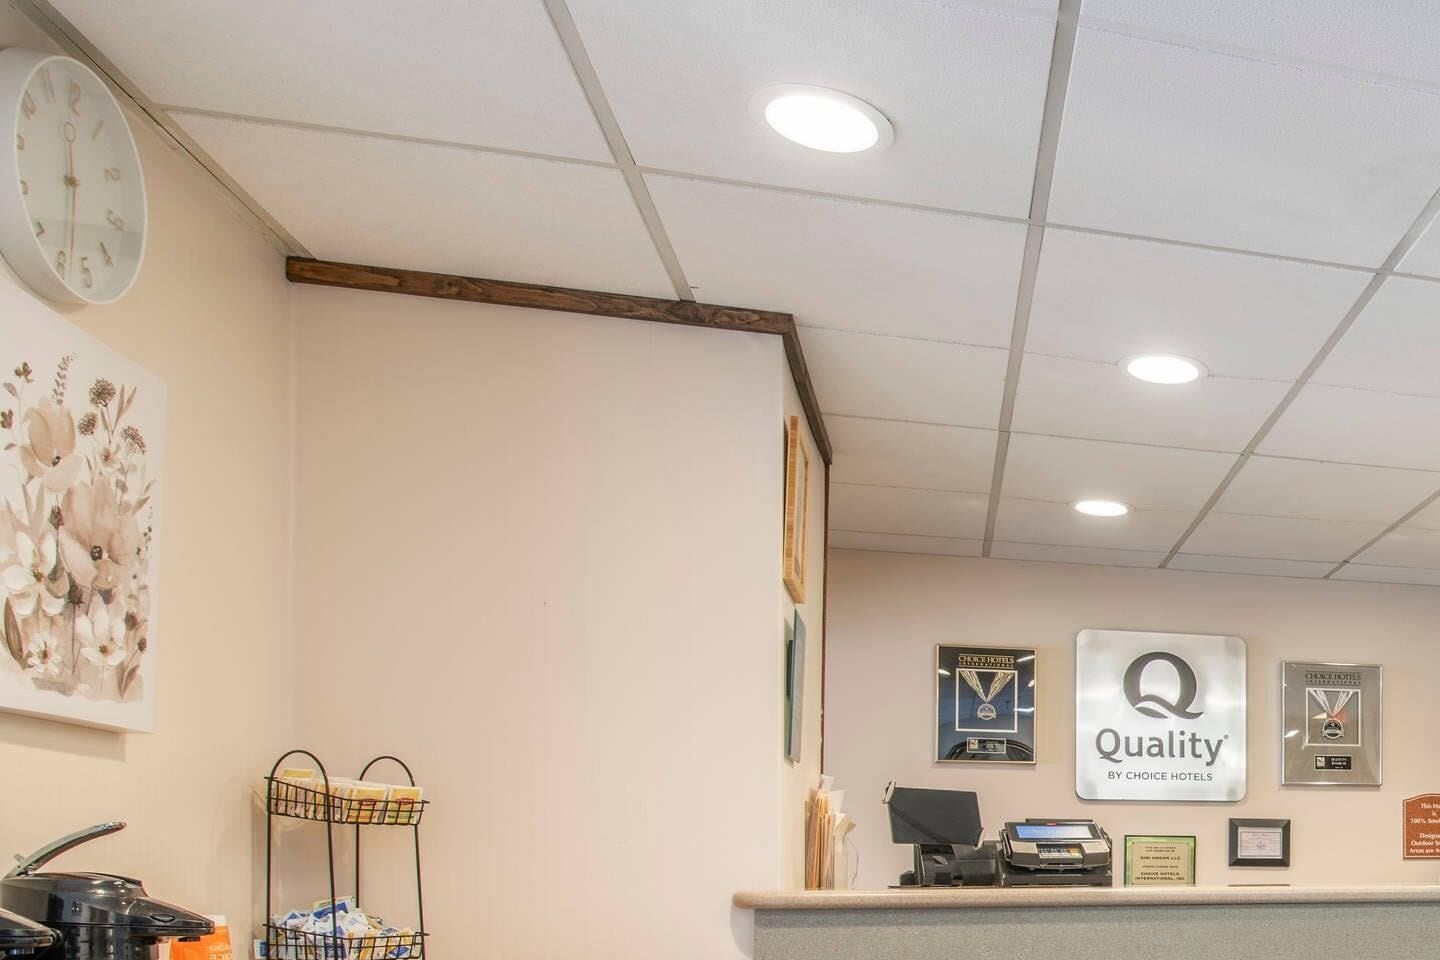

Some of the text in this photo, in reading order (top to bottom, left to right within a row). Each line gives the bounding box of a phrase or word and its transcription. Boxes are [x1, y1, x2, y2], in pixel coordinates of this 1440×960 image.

[81, 256, 93, 288] 5
[958, 655, 985, 663] CHOICE
[1096, 728, 1224, 767] Quality
[1108, 771, 1213, 782] BY CHOICE HOTELS
